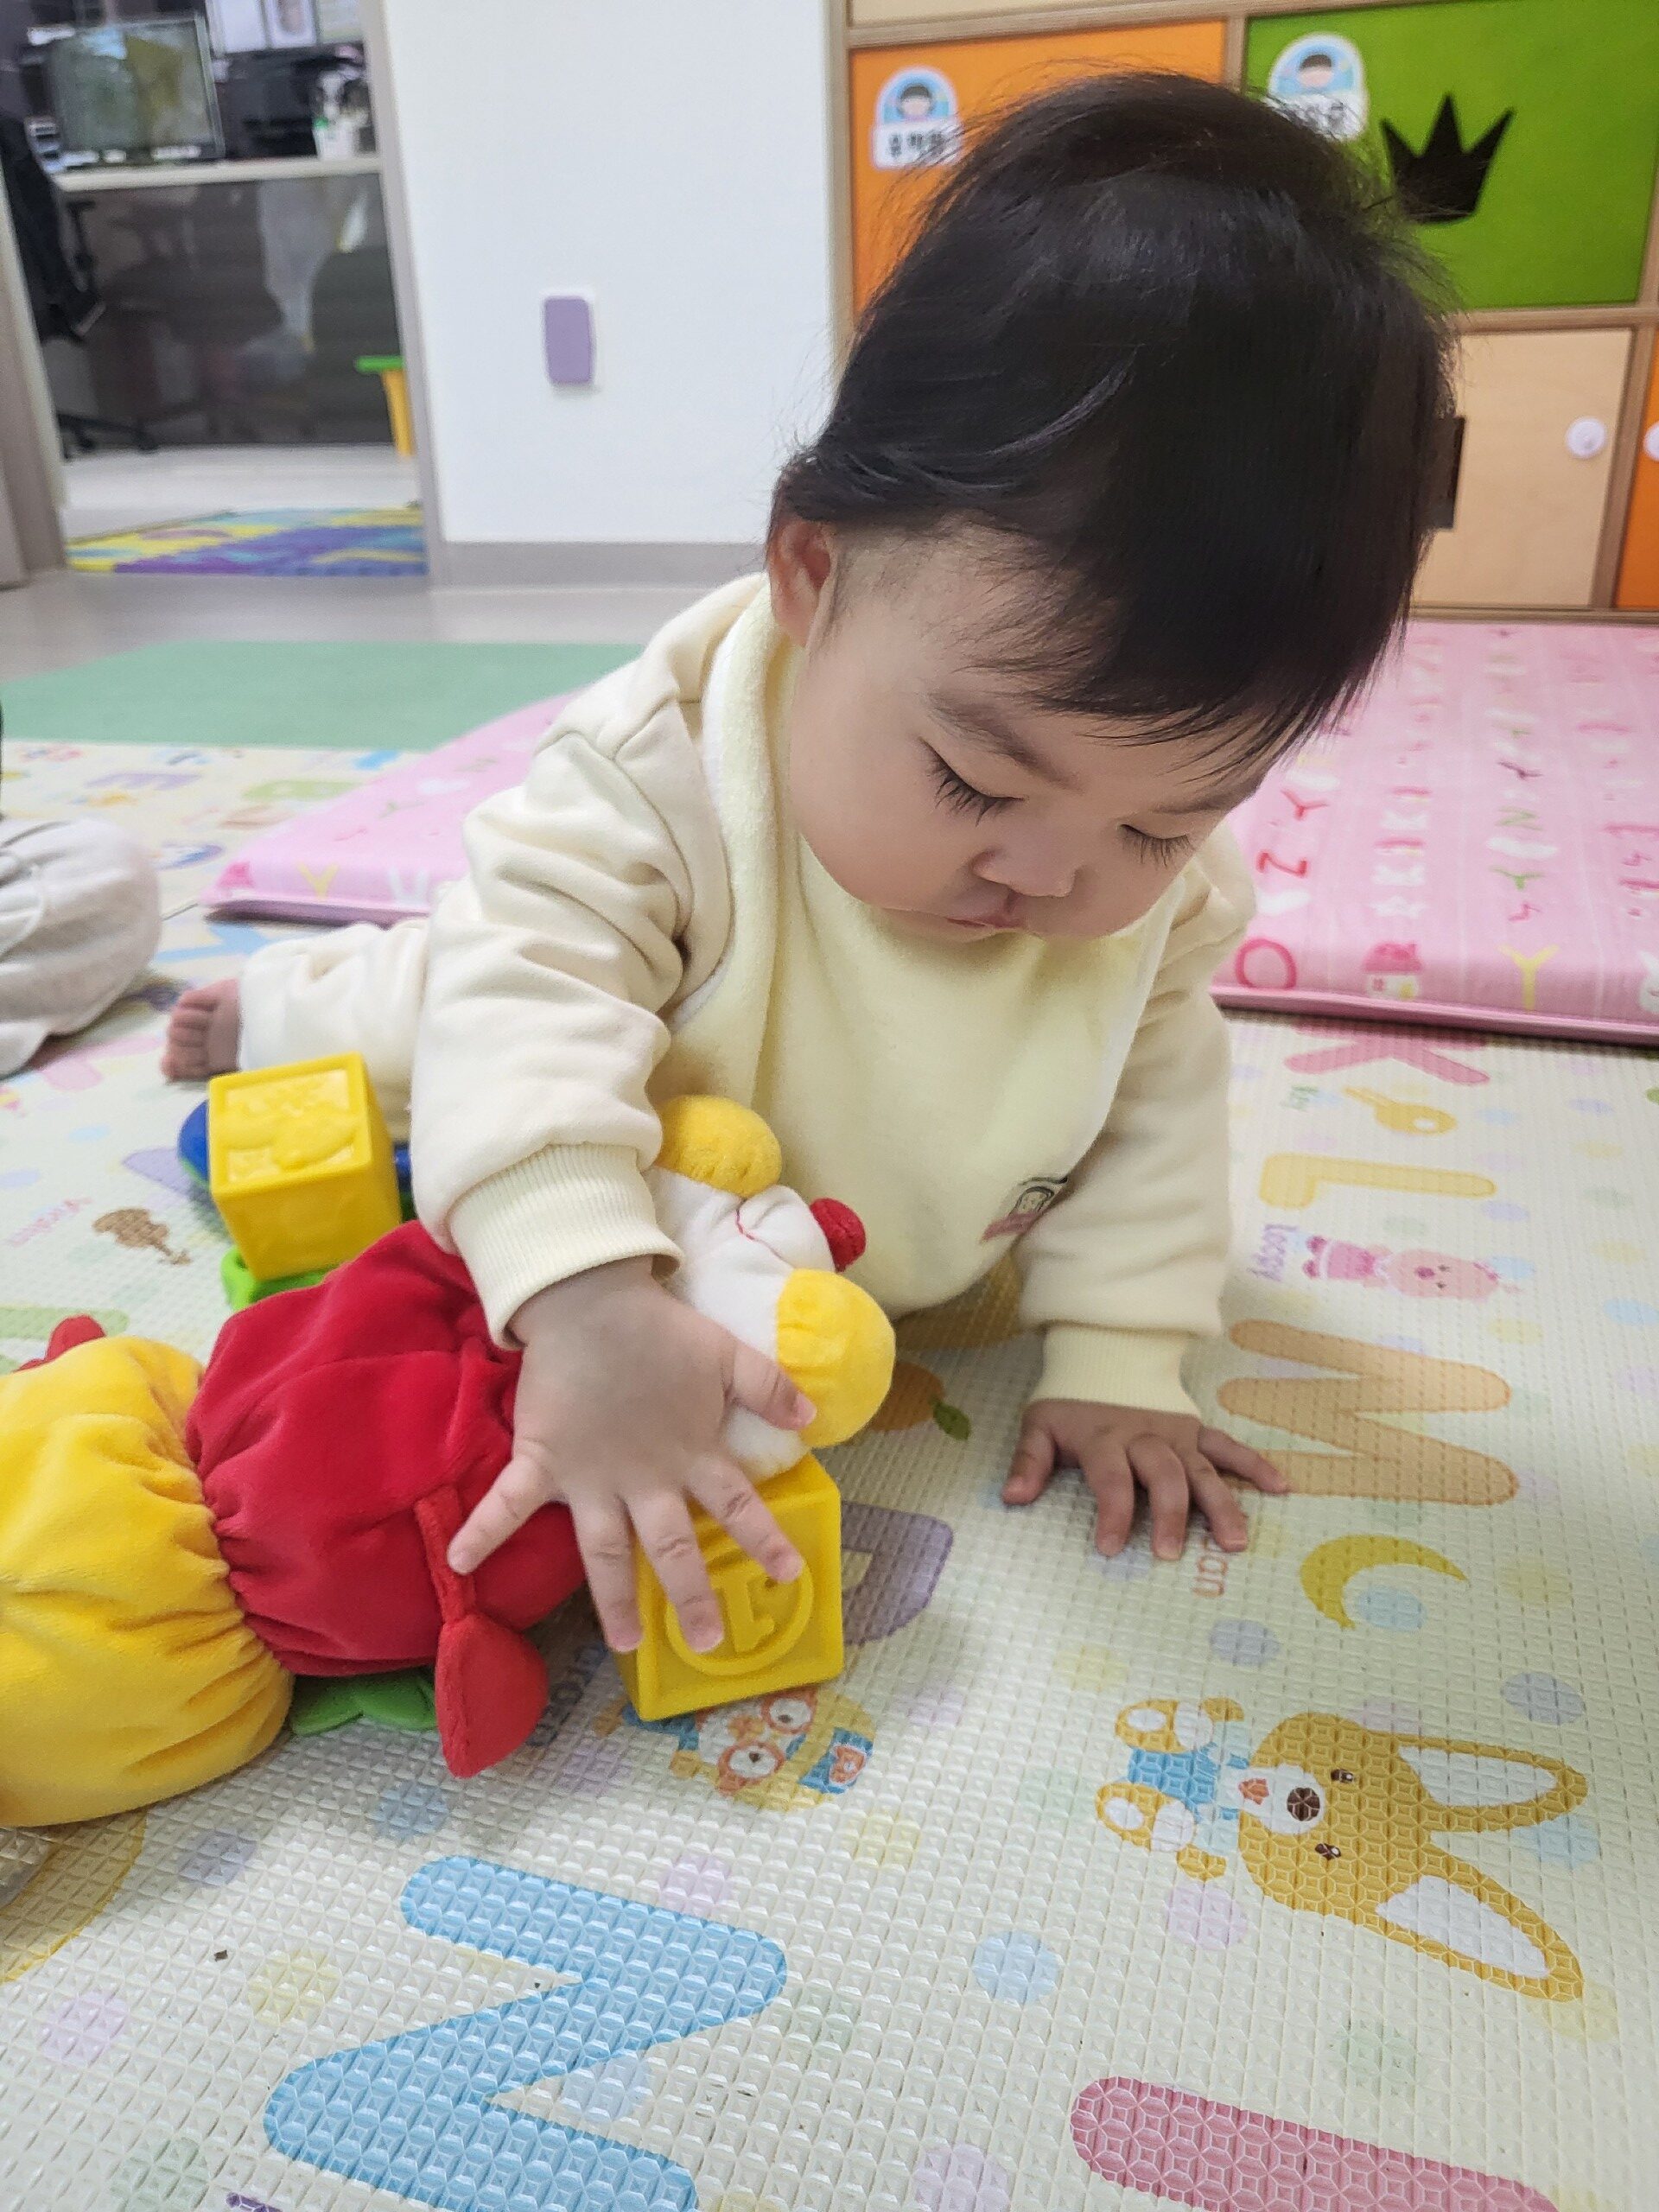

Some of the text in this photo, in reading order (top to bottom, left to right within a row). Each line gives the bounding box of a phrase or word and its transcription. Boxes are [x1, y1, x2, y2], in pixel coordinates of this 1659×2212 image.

[1284, 1018, 1491, 1086] K
[1259, 1152, 1497, 1209] L
[1218, 1320, 1516, 1505] M
